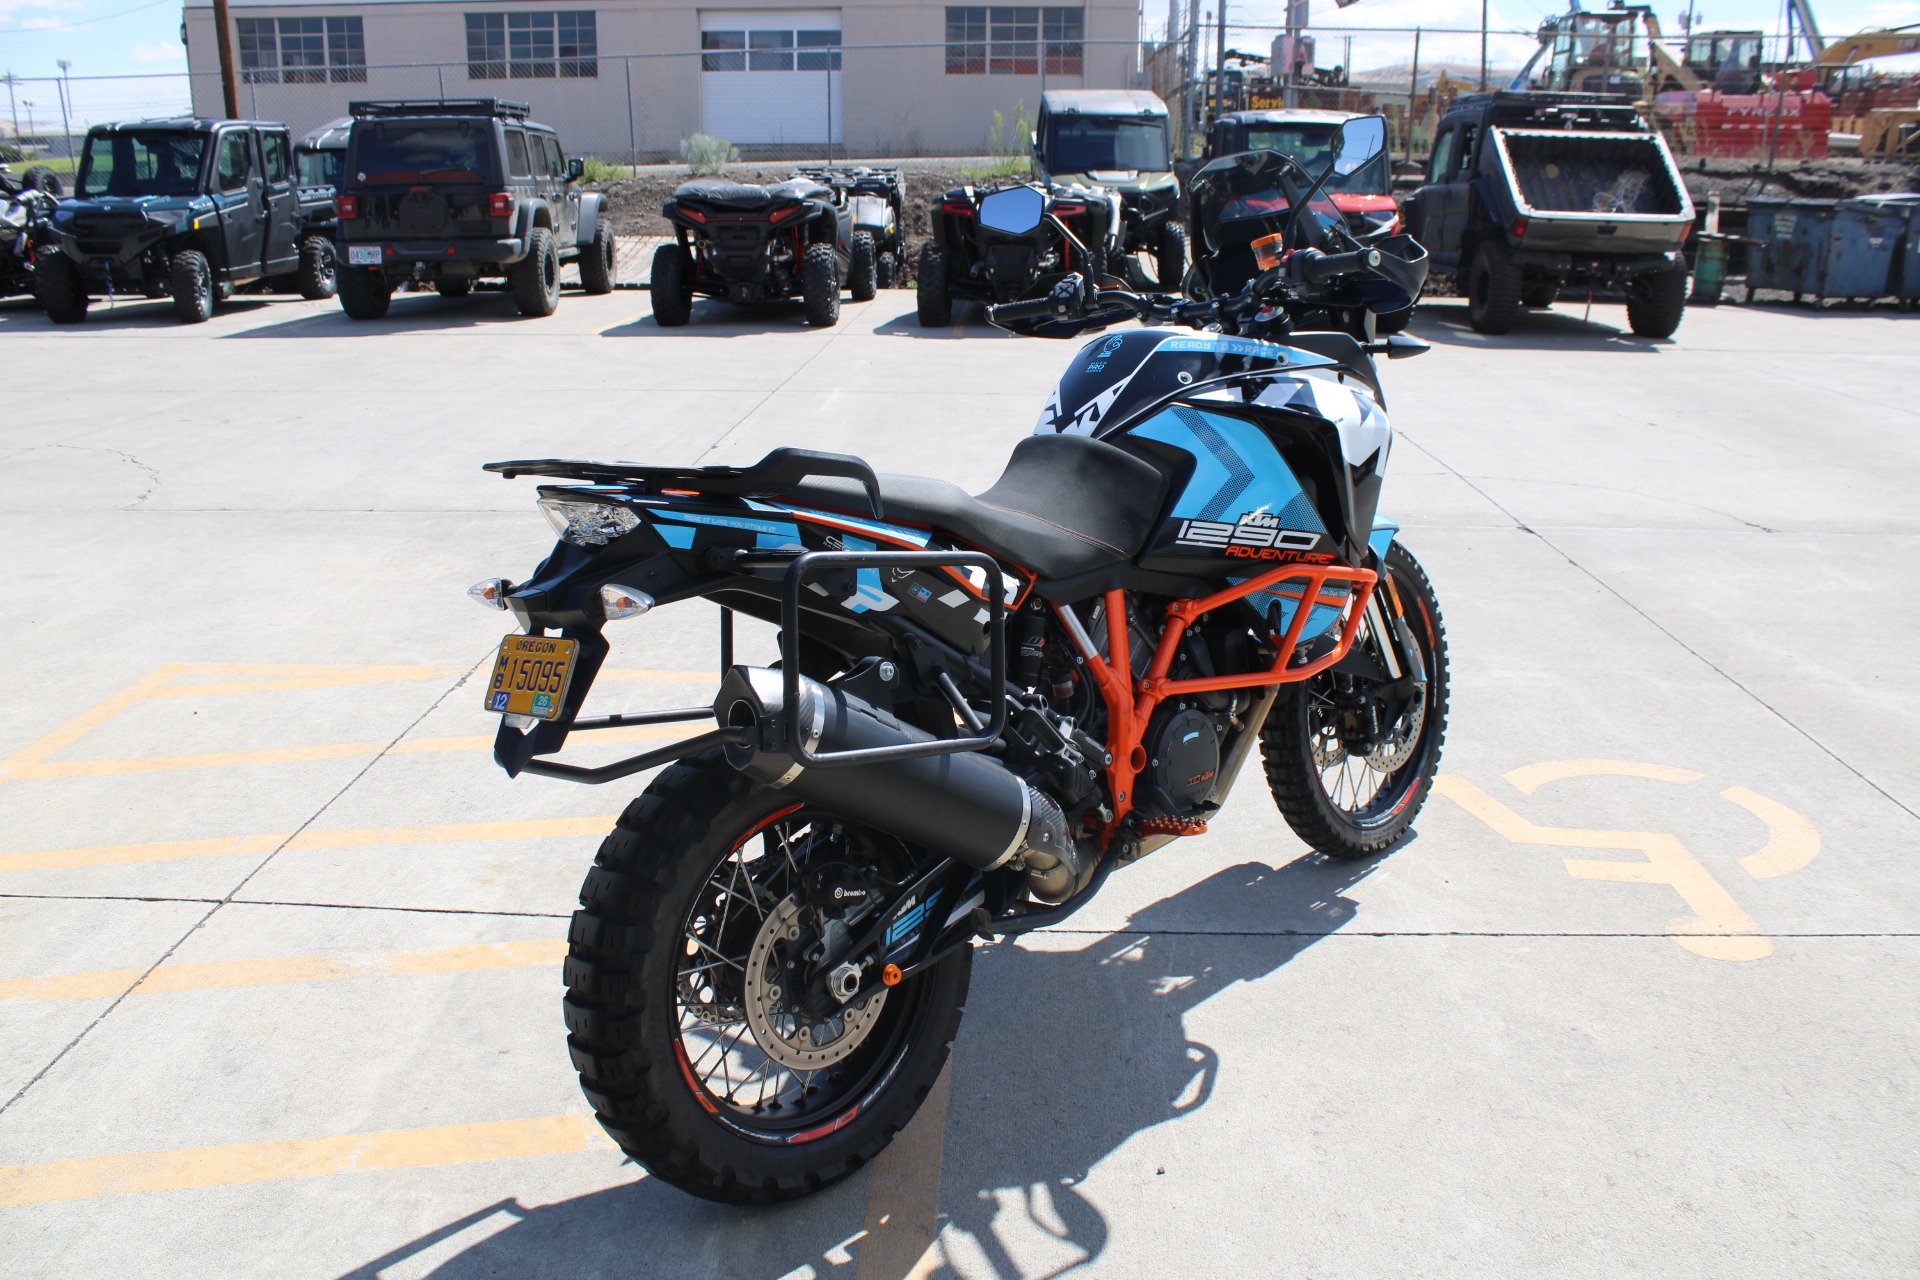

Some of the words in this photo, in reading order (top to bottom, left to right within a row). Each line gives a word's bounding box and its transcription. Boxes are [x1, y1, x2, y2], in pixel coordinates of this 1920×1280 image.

[1252, 95, 1284, 109] Servi
[1170, 340, 1211, 350] READY
[1214, 342, 1228, 351] TO
[1245, 345, 1275, 356] RACE
[684, 513, 701, 521] RIDE
[712, 518, 728, 526] LIKE
[729, 520, 743, 528] YOU
[744, 522, 767, 532] STOLE
[1240, 513, 1280, 528] KTM
[1177, 520, 1321, 551] 1290
[1225, 545, 1337, 564] ADVENTURE
[515, 640, 557, 654] OREGON
[508, 657, 566, 694] 15095
[493, 693, 508, 710] 12
[537, 695, 549, 706] 26
[843, 889, 866, 897] brembo
